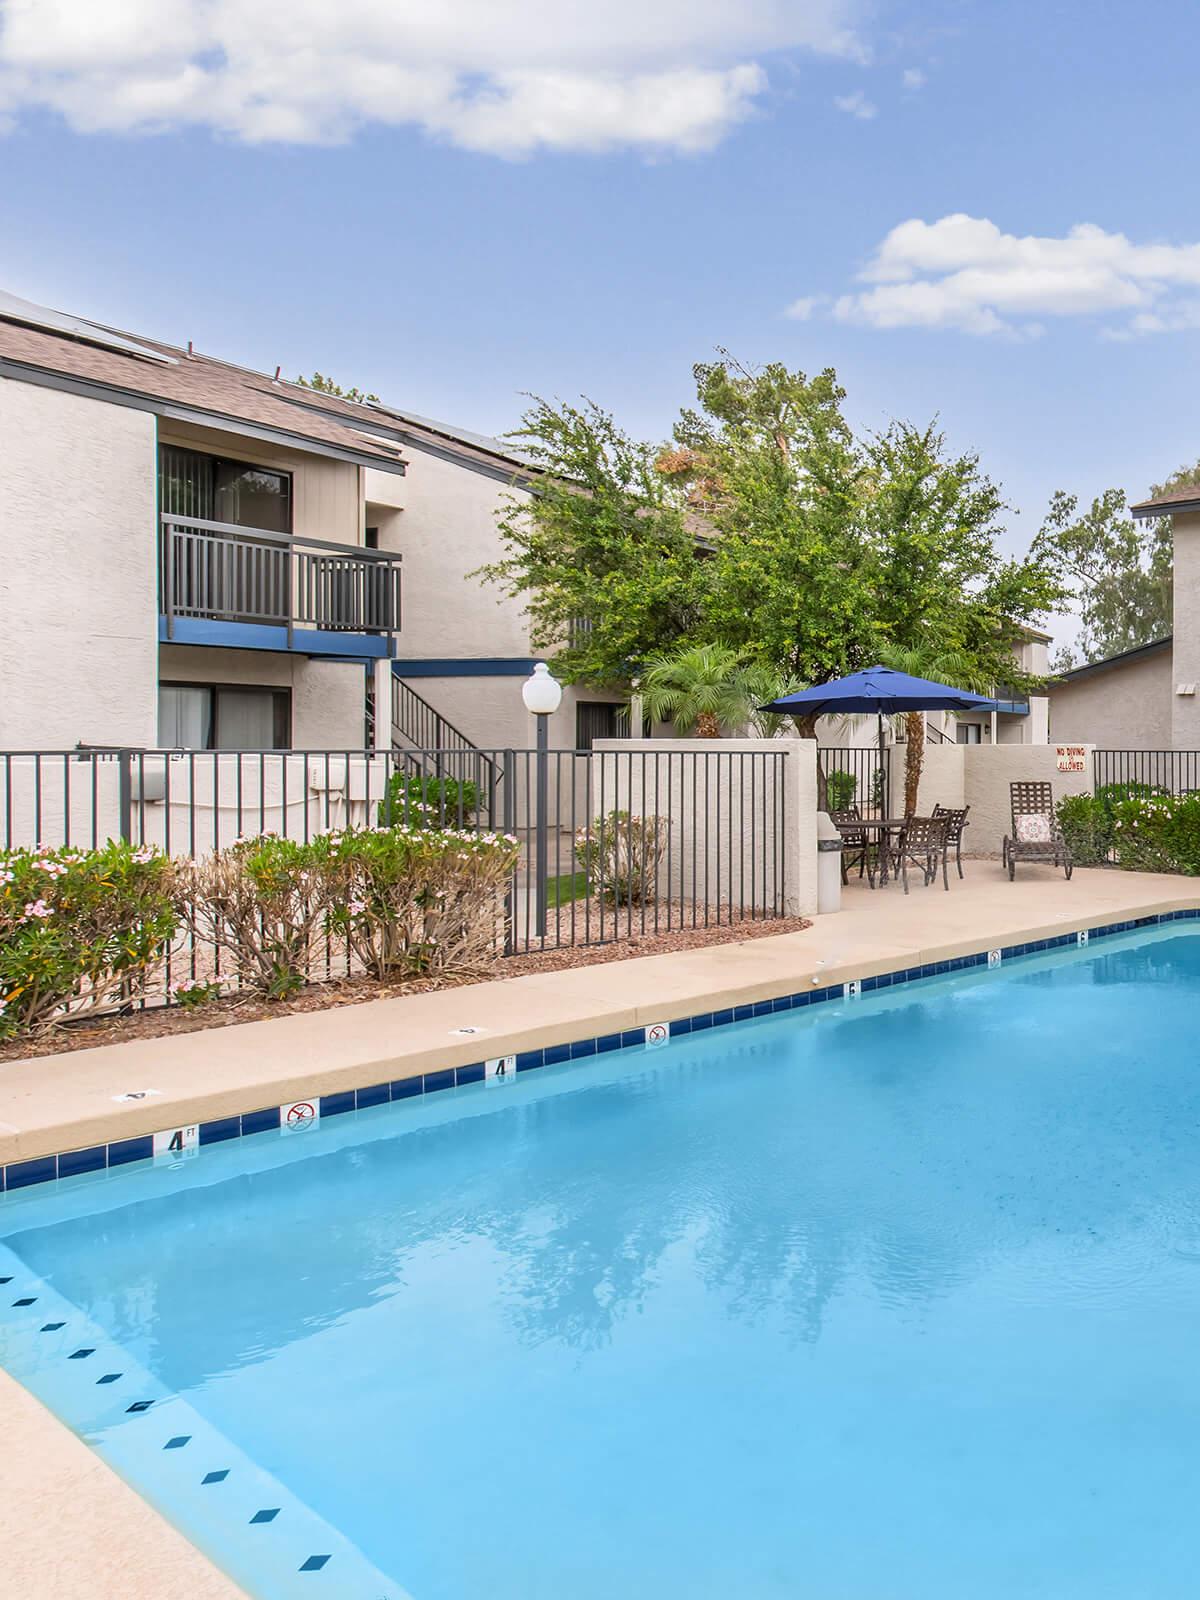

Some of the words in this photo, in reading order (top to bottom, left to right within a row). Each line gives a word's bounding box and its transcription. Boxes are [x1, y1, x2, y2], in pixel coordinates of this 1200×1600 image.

[1056, 748, 1065, 756] NO
[1067, 747, 1085, 756] DIVING
[1059, 761, 1084, 770] ALLOWED
[496, 1059, 505, 1075] 4
[168, 1130, 186, 1151] 4
